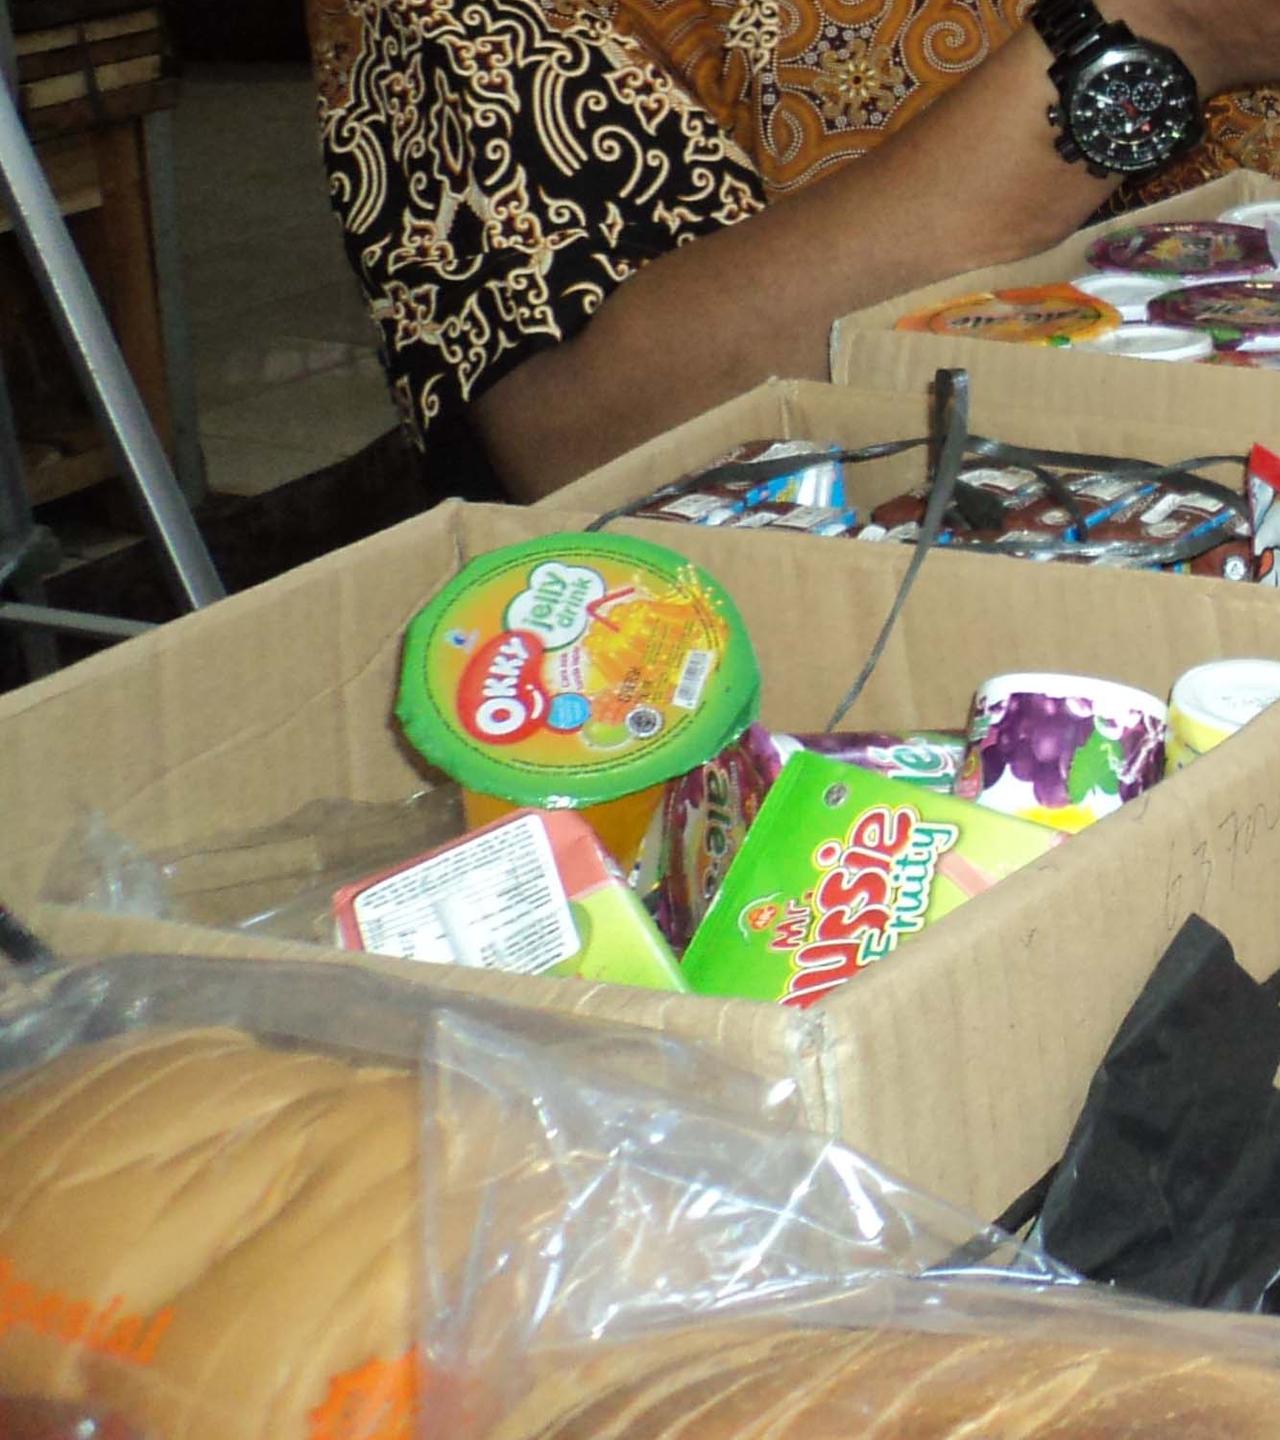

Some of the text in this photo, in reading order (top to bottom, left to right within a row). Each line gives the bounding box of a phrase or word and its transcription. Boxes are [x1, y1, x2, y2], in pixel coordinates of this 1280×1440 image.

[522, 569, 569, 631] jelly
[557, 575, 593, 630] drink
[861, 821, 958, 964] Fruity
